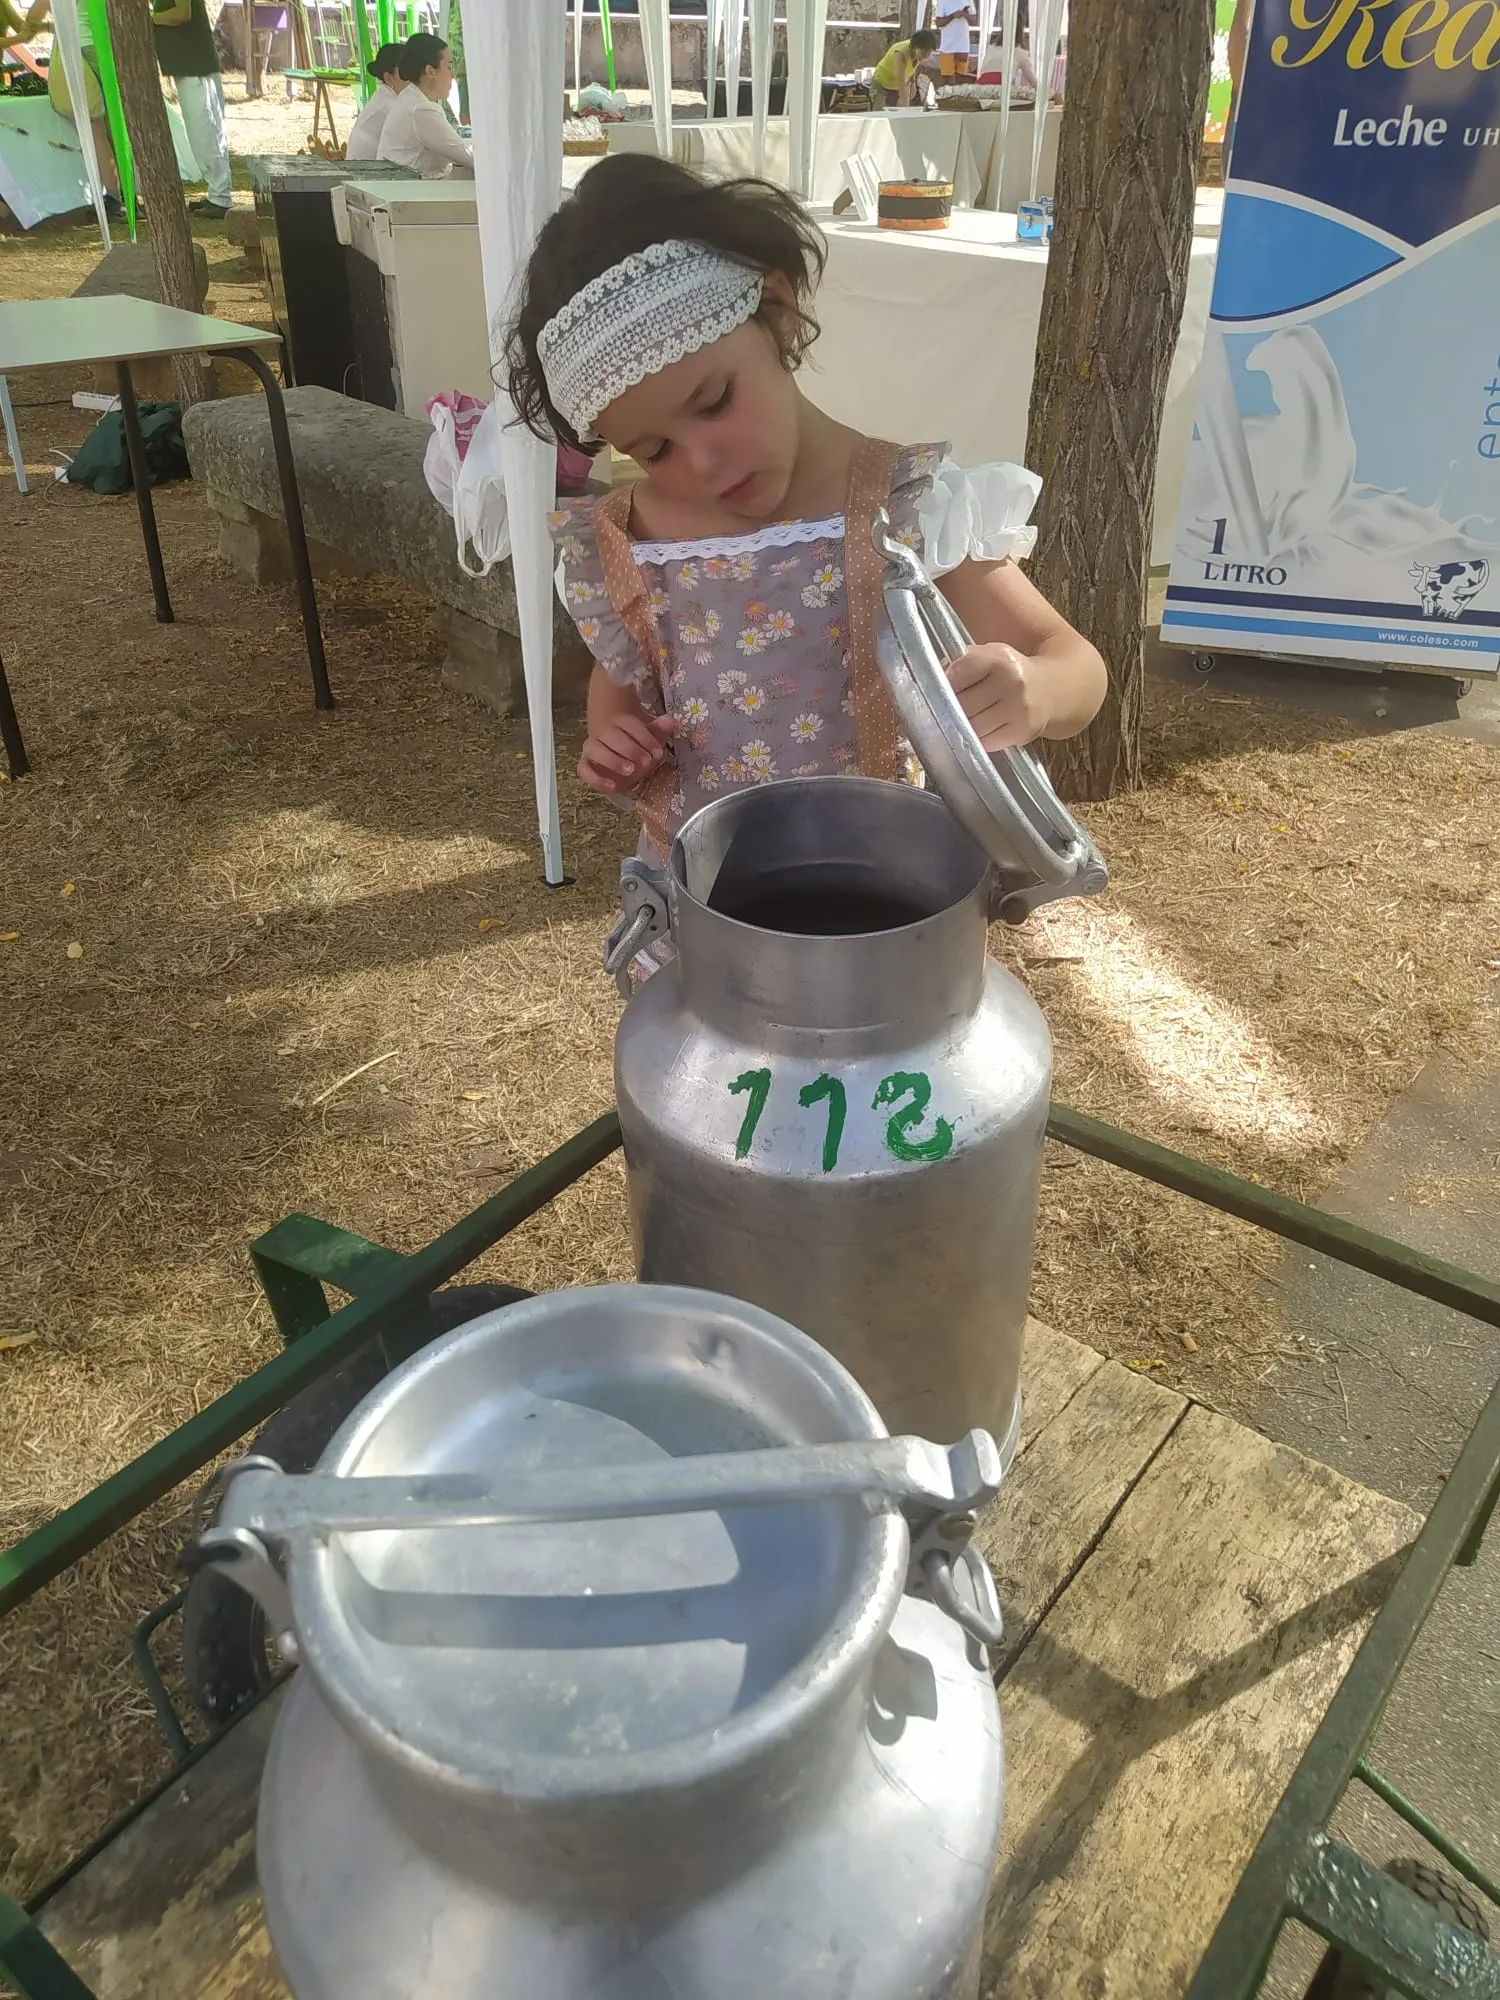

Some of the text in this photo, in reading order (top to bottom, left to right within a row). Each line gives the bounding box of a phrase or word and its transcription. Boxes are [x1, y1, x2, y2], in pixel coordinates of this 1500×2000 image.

[1333, 104, 1448, 147] Leche
[1207, 517, 1228, 556] 1
[1203, 561, 1288, 586] LITRO
[1377, 631, 1479, 649] www.coleso.com
